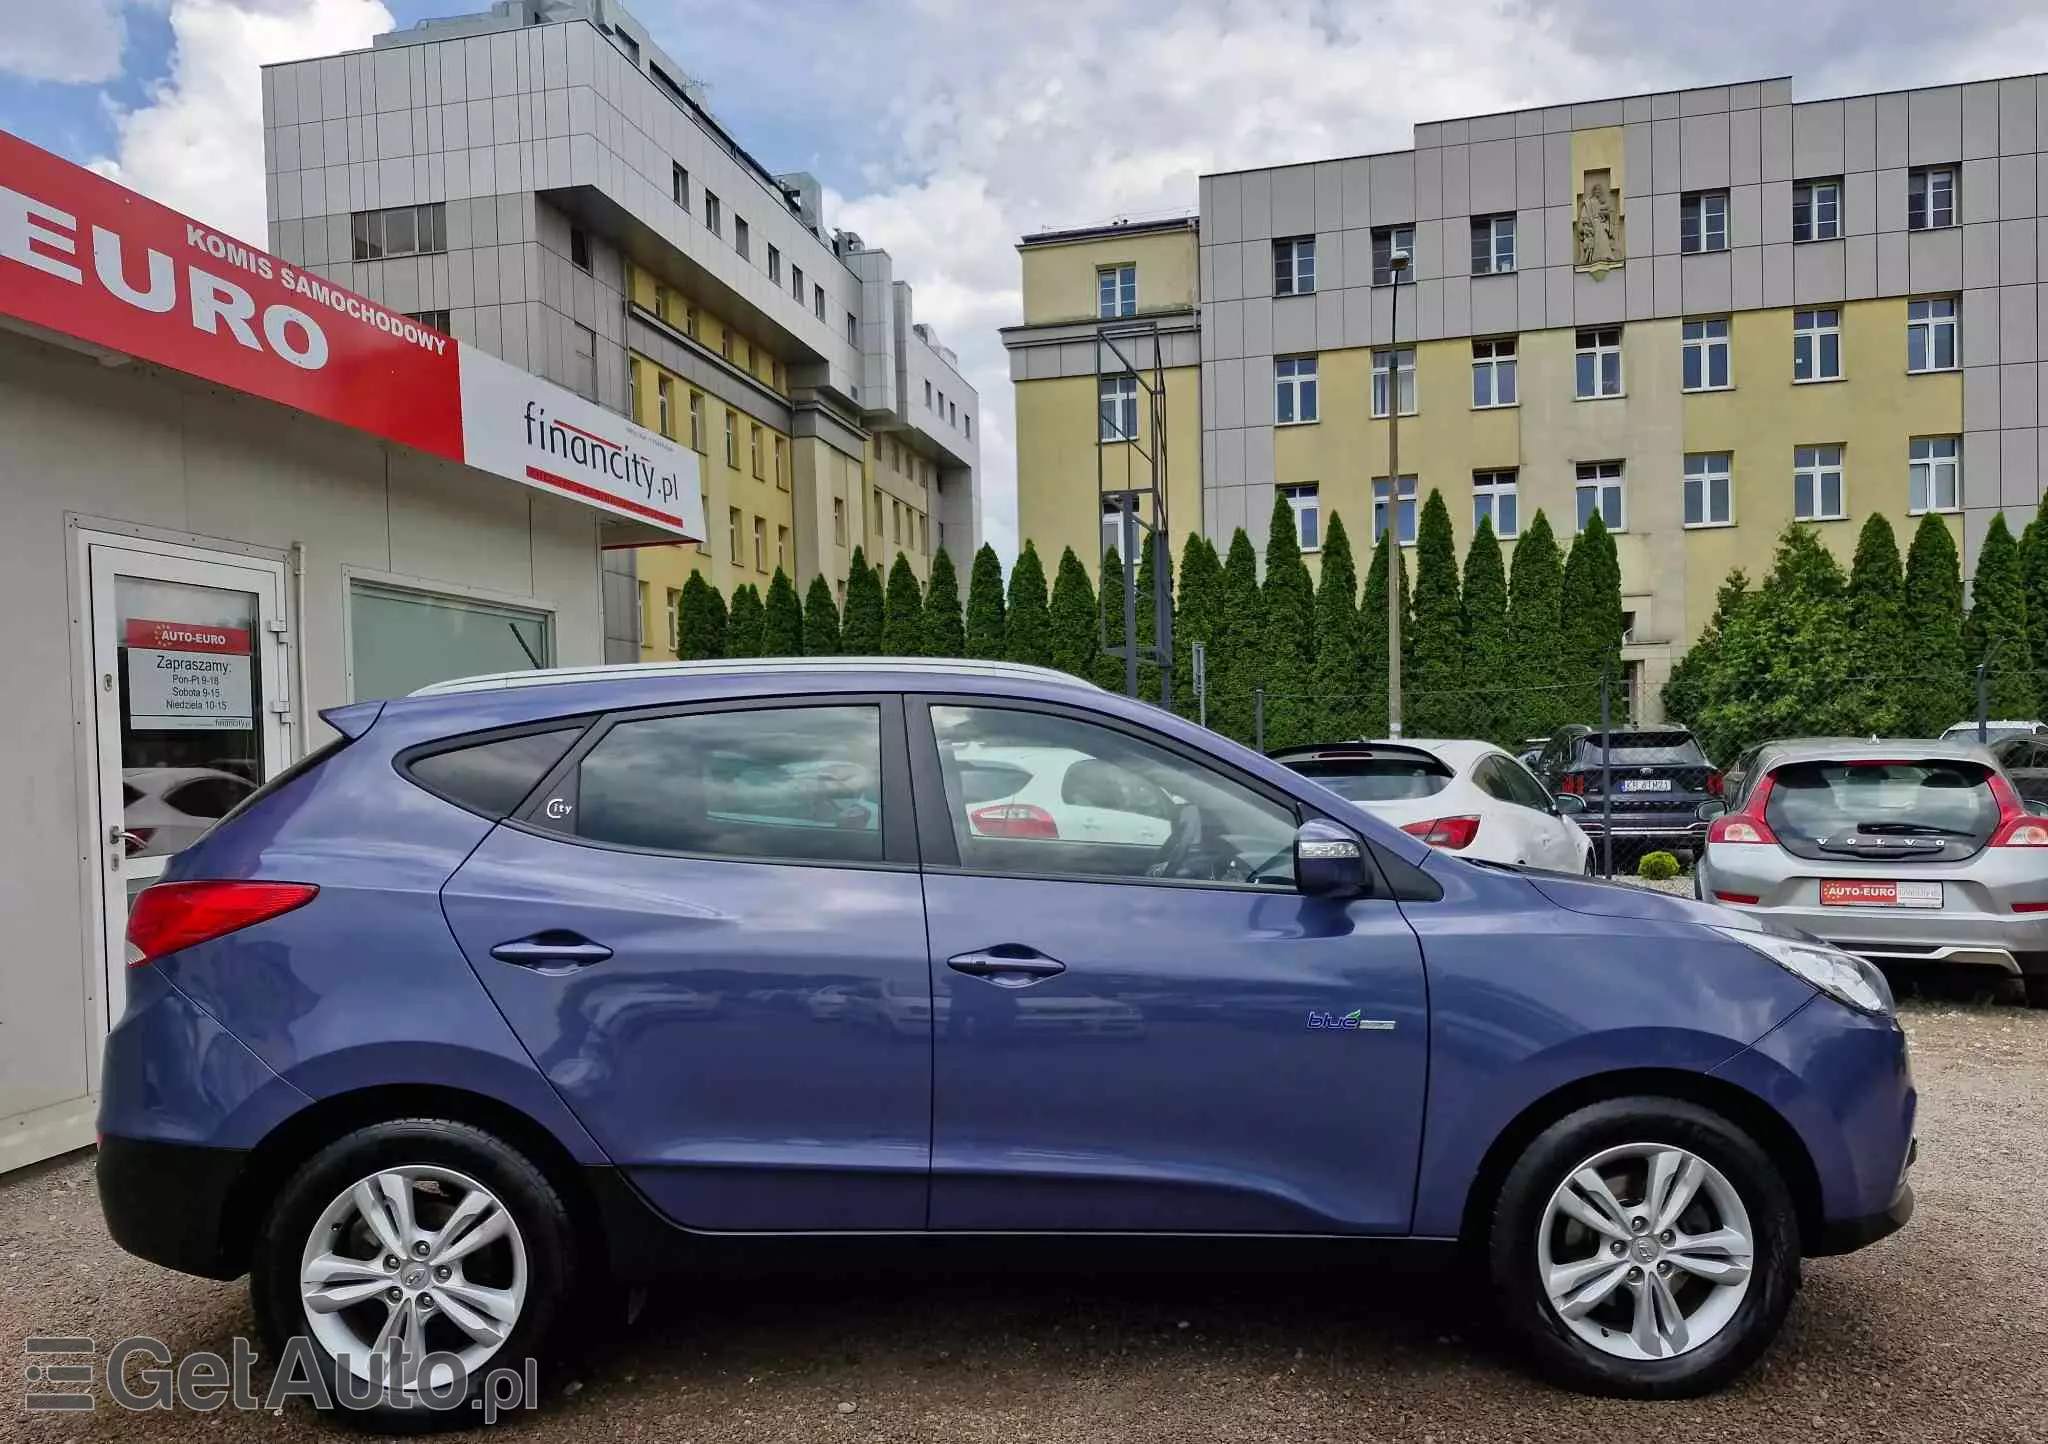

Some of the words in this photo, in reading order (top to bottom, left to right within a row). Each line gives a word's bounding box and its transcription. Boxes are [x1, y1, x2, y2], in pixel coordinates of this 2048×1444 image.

[186, 223, 273, 280] KOMIS
[280, 266, 446, 356] SAMOCHODOWY
[524, 401, 679, 503] financity.pl
[161, 630, 226, 645] AUTO-EURO
[156, 655, 232, 675] Zapraszamy:
[172, 687, 201, 697] Sobota
[1816, 838, 1945, 847] VOLVO
[1828, 887, 1896, 897] AUTO-EURO
[1306, 1010, 1360, 1029] blue
